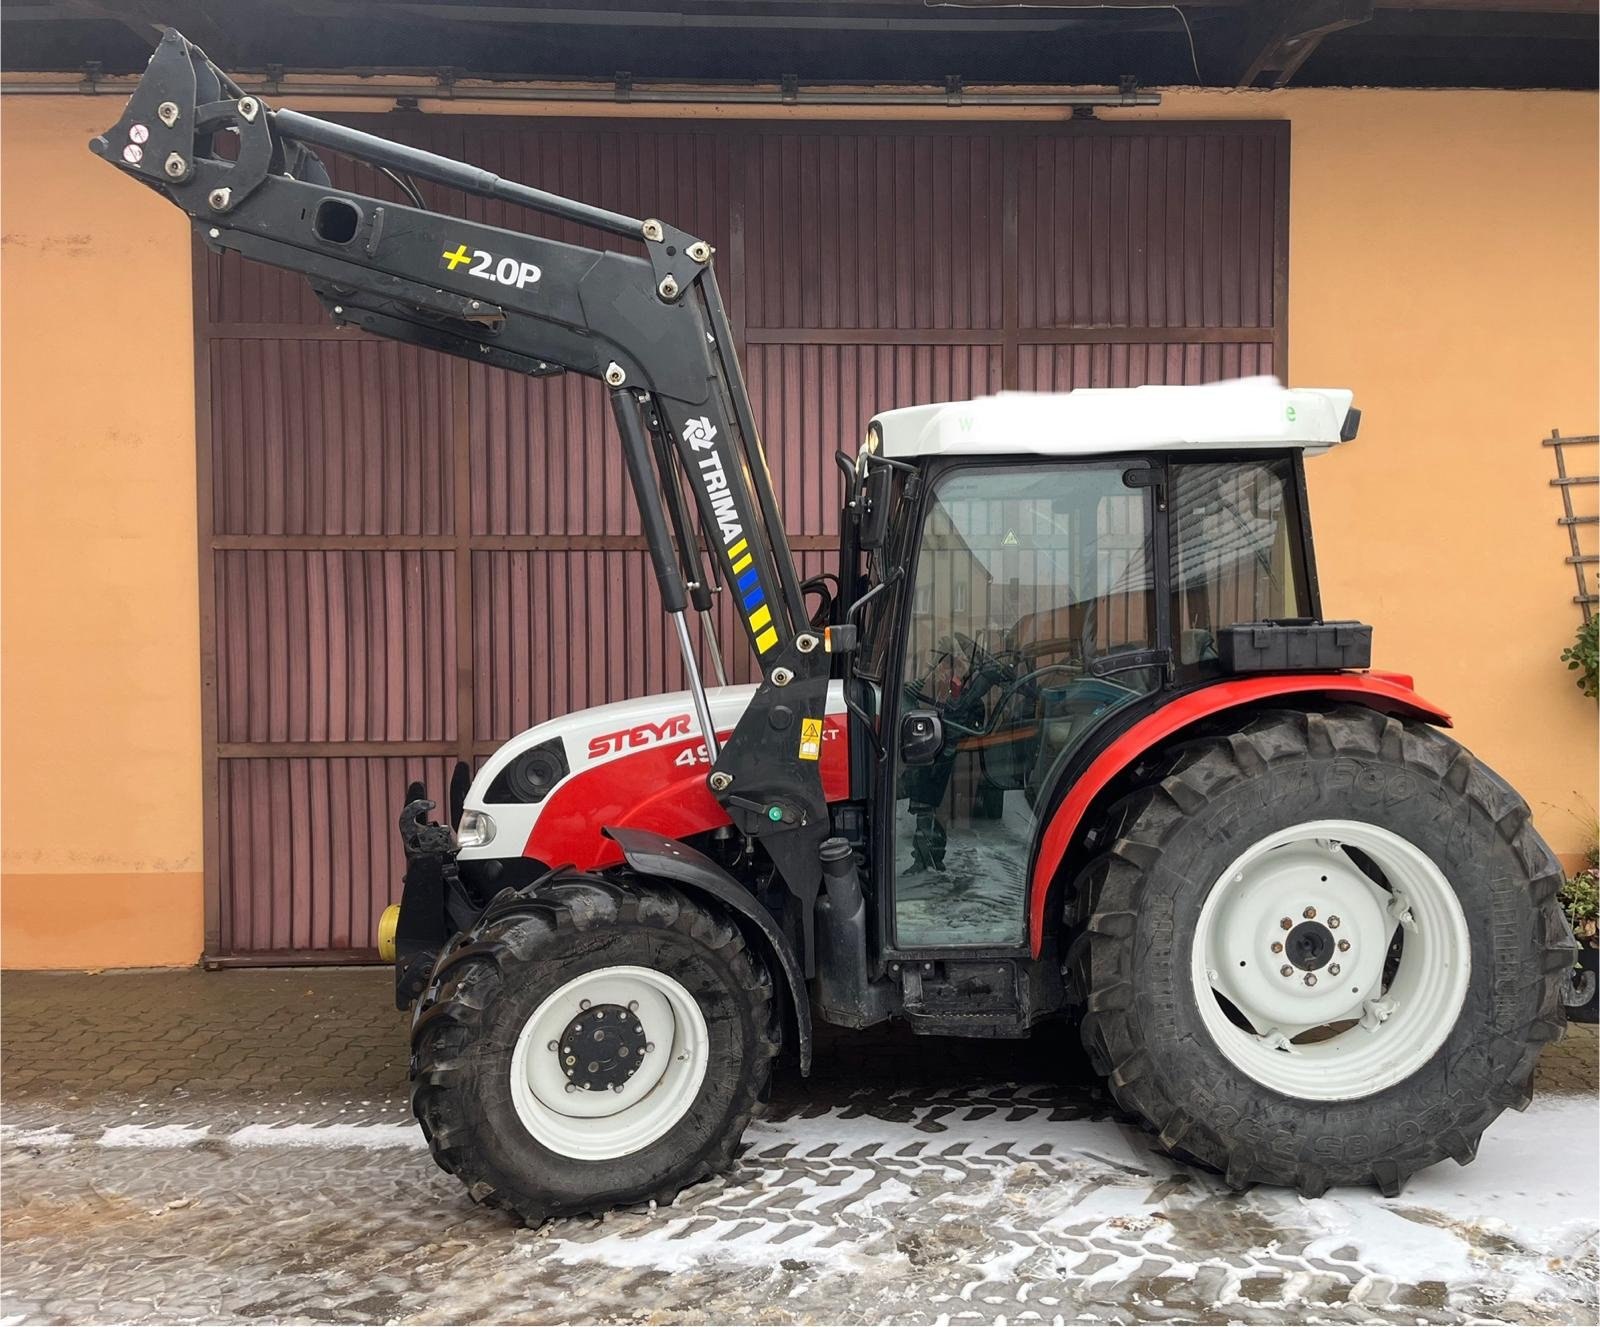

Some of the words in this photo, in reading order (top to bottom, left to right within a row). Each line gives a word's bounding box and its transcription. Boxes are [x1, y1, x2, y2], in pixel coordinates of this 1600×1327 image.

[442, 245, 542, 289] +2.0P
[698, 450, 743, 545] TRIMA
[588, 713, 692, 760] STEYR
